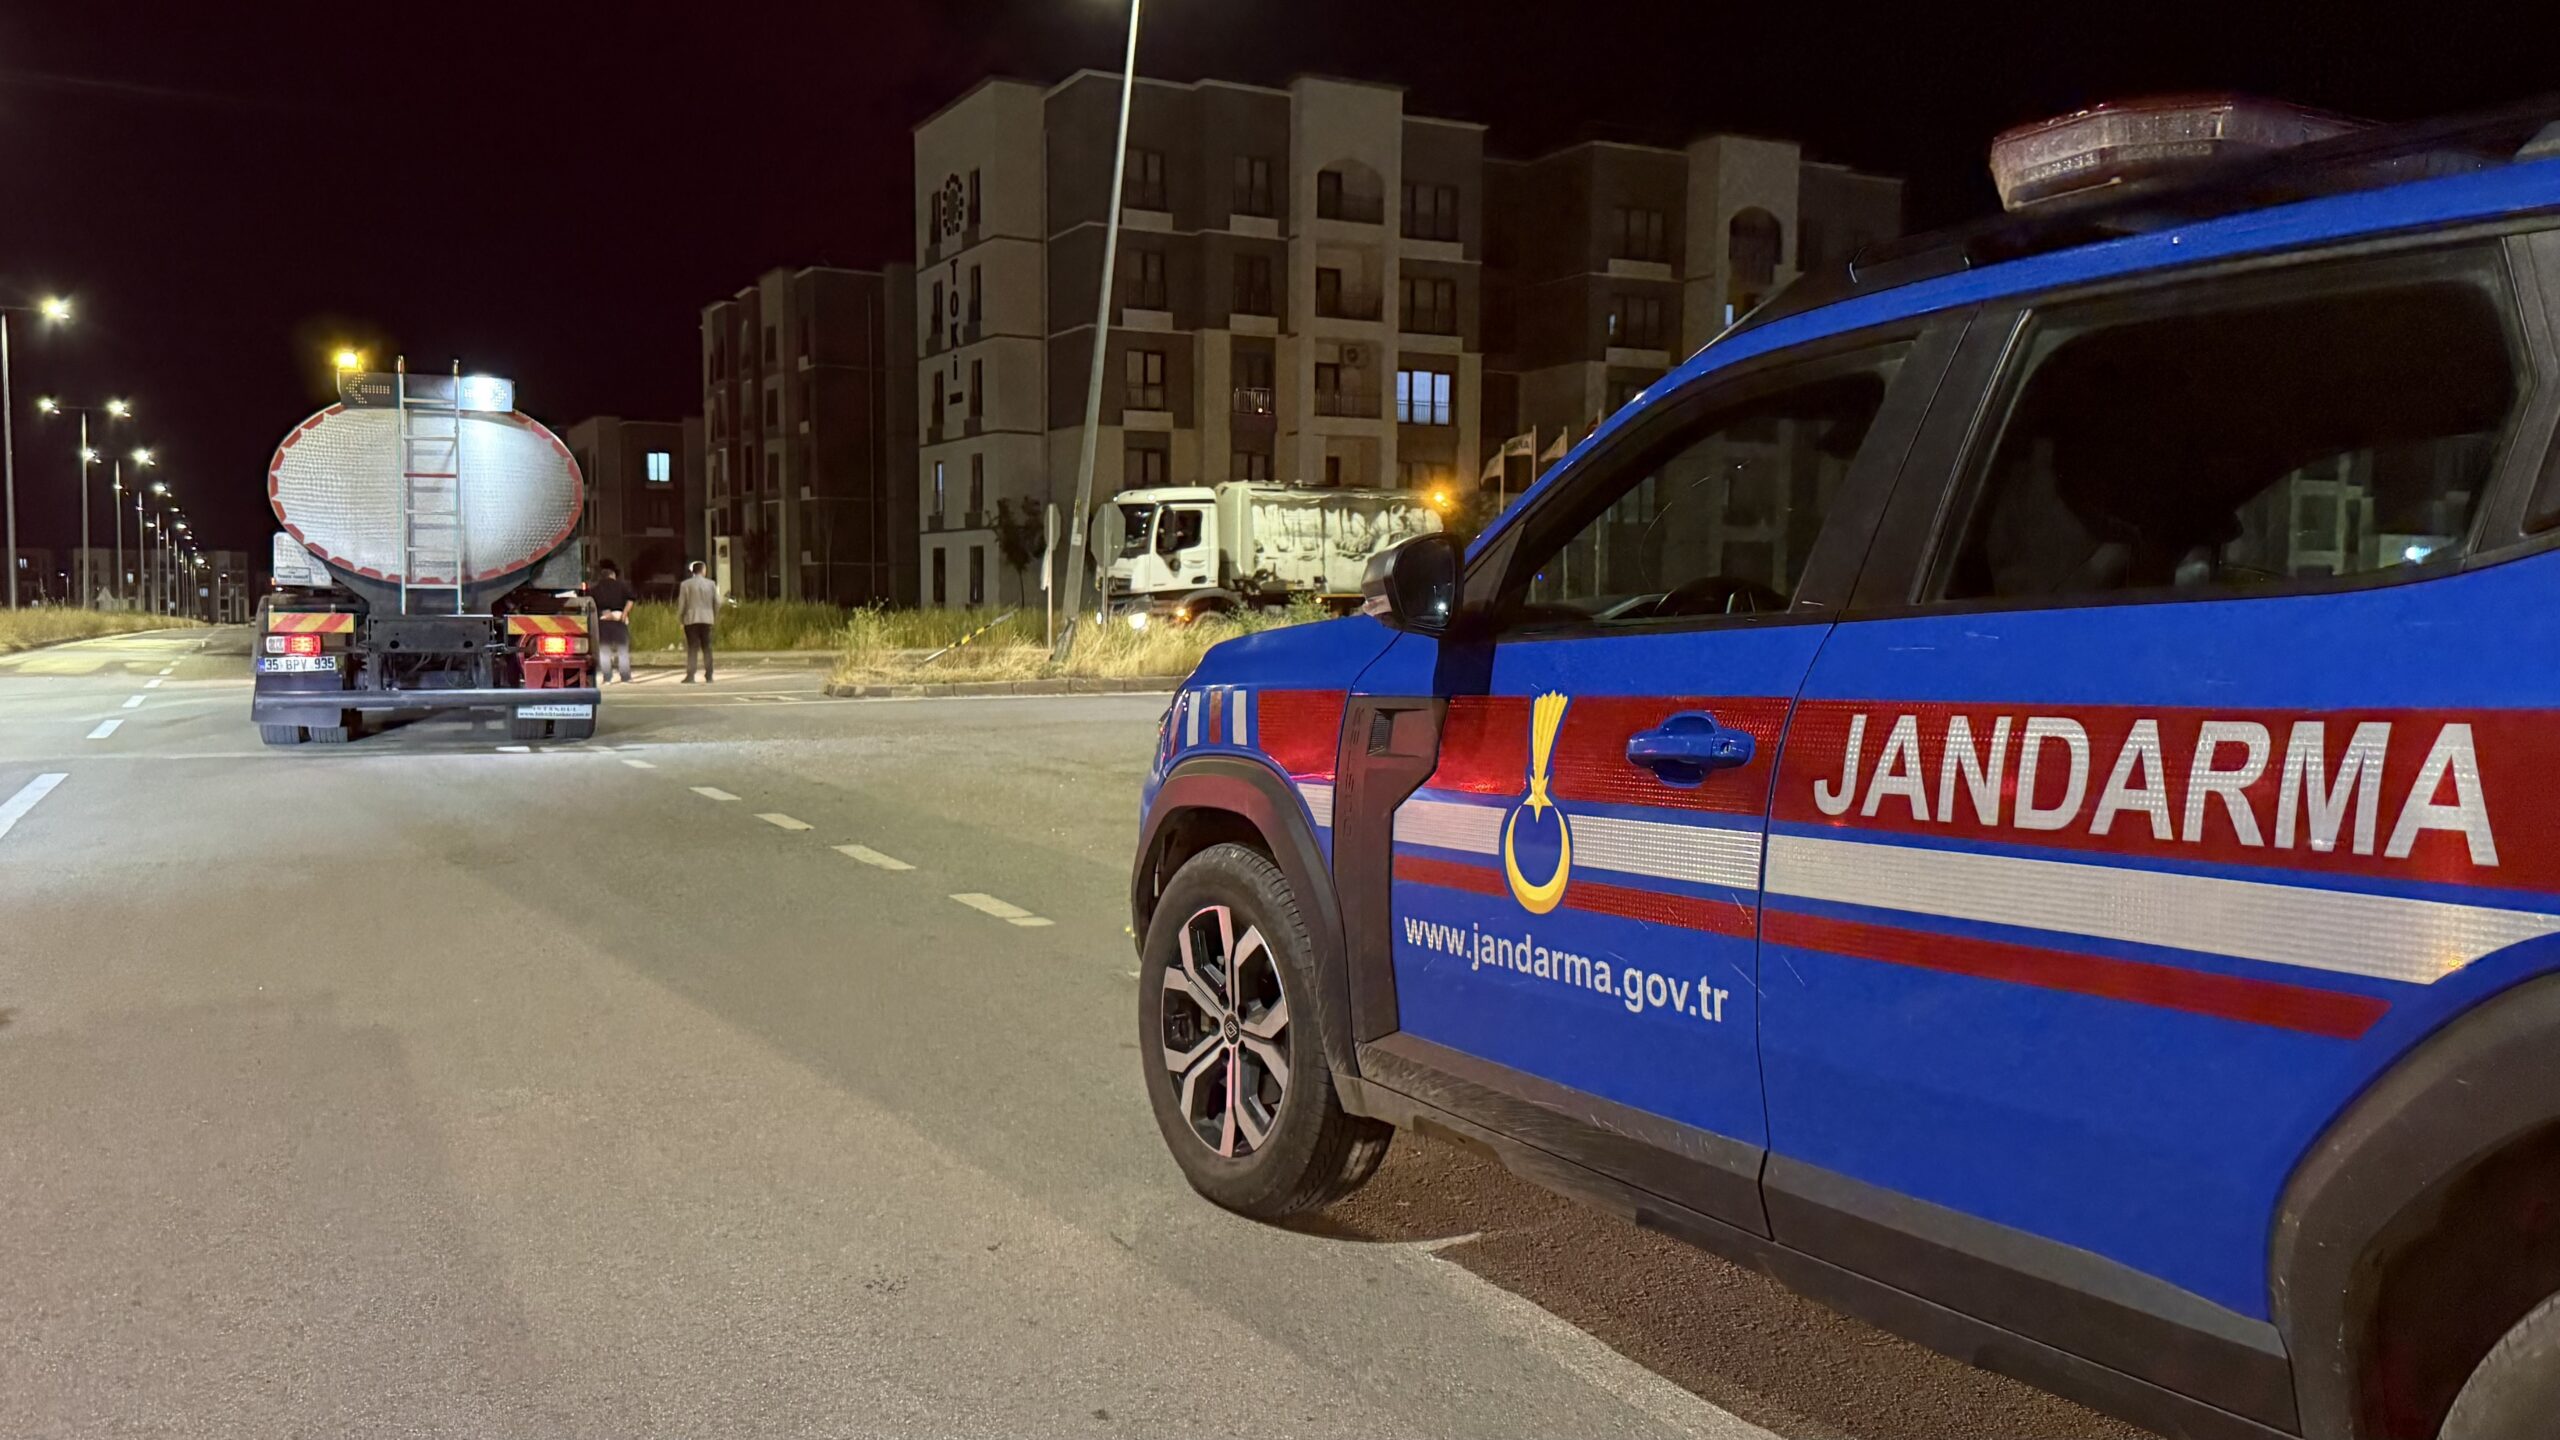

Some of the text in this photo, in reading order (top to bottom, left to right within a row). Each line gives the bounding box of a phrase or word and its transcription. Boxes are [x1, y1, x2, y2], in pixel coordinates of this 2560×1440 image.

[266, 659, 279, 670] 35
[314, 658, 334, 669] 935
[1813, 713, 2500, 867] JANDARMA
[1404, 915, 1728, 1023] www.jandarma.gov.tr
